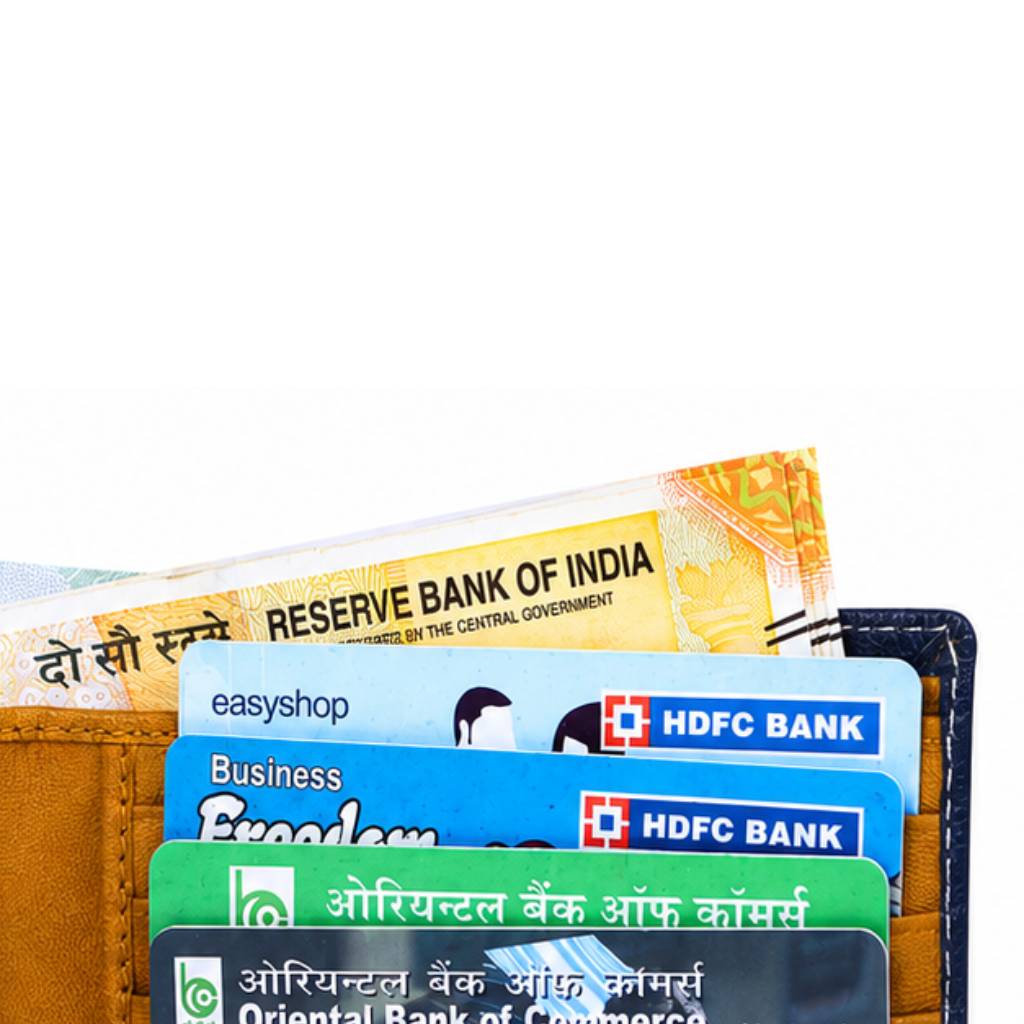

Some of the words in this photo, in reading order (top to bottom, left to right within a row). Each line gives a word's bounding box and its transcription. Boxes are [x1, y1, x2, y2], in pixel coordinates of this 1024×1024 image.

[266, 585, 414, 641] RESERVE
[418, 567, 510, 615] BANK
[516, 557, 558, 596] OF
[566, 540, 654, 588] INDIA
[427, 621, 453, 640] THE
[457, 609, 519, 634] CENTRAL
[522, 591, 614, 623] GOVERNMENT
[33, 638, 84, 688] दो
[91, 623, 142, 676] सौ
[211, 689, 350, 726] easyshop
[662, 709, 754, 738] HDFC
[766, 711, 865, 741] BANK
[210, 752, 343, 792] Business
[642, 812, 734, 843] HDFC
[745, 819, 843, 850] BANK
[325, 874, 508, 924] ओरियन्टल
[519, 879, 588, 925] बैंक
[238, 959, 410, 997] ओरियन्टल
[427, 959, 487, 997] बैंक
